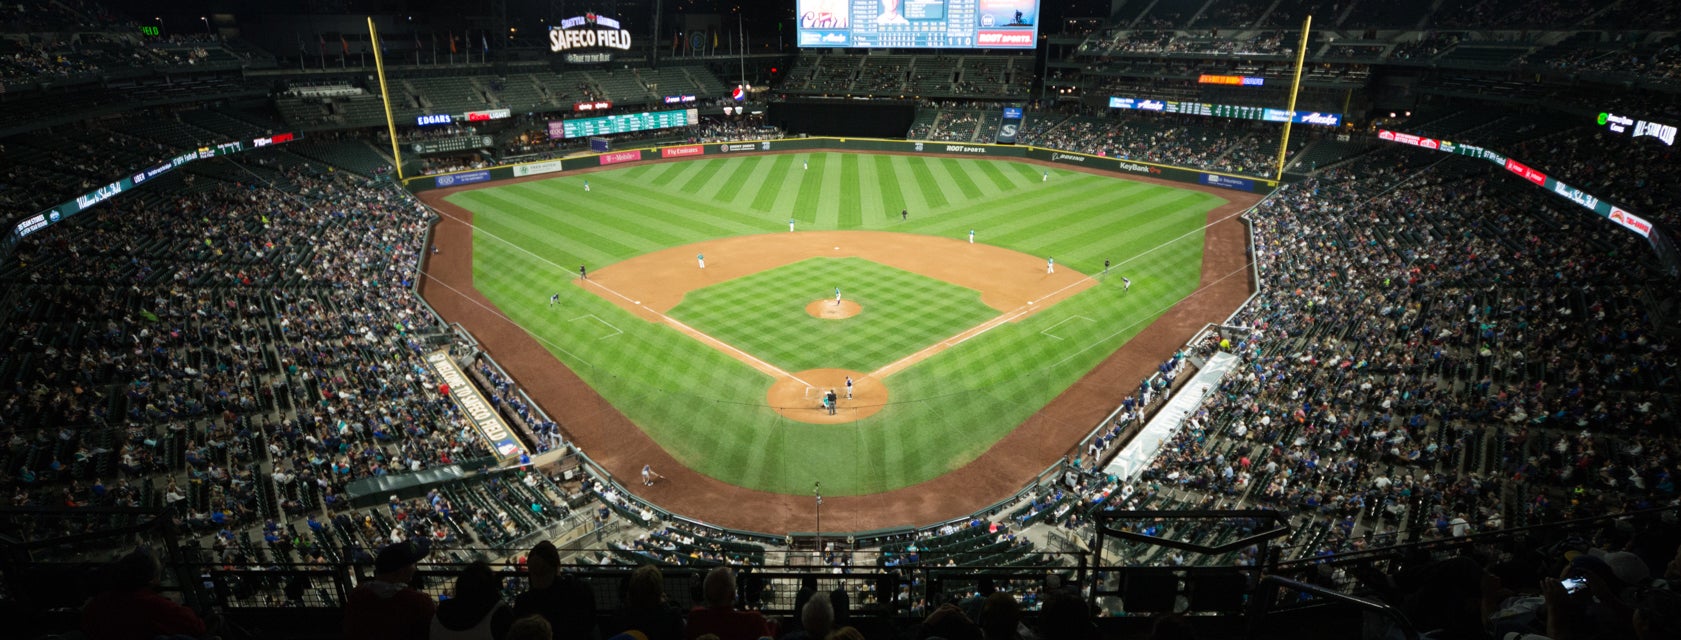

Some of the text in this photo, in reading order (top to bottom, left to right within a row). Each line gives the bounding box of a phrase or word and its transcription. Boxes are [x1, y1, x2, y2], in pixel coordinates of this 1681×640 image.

[549, 29, 632, 52] SAFECO FIELD
[979, 33, 1002, 43] ROOT
[417, 114, 451, 125] EDGARS
[1302, 112, 1338, 125] Alaska
[1120, 162, 1149, 173] KeyBank
[434, 360, 508, 441] WELCOME TO SAFECO FIELD
